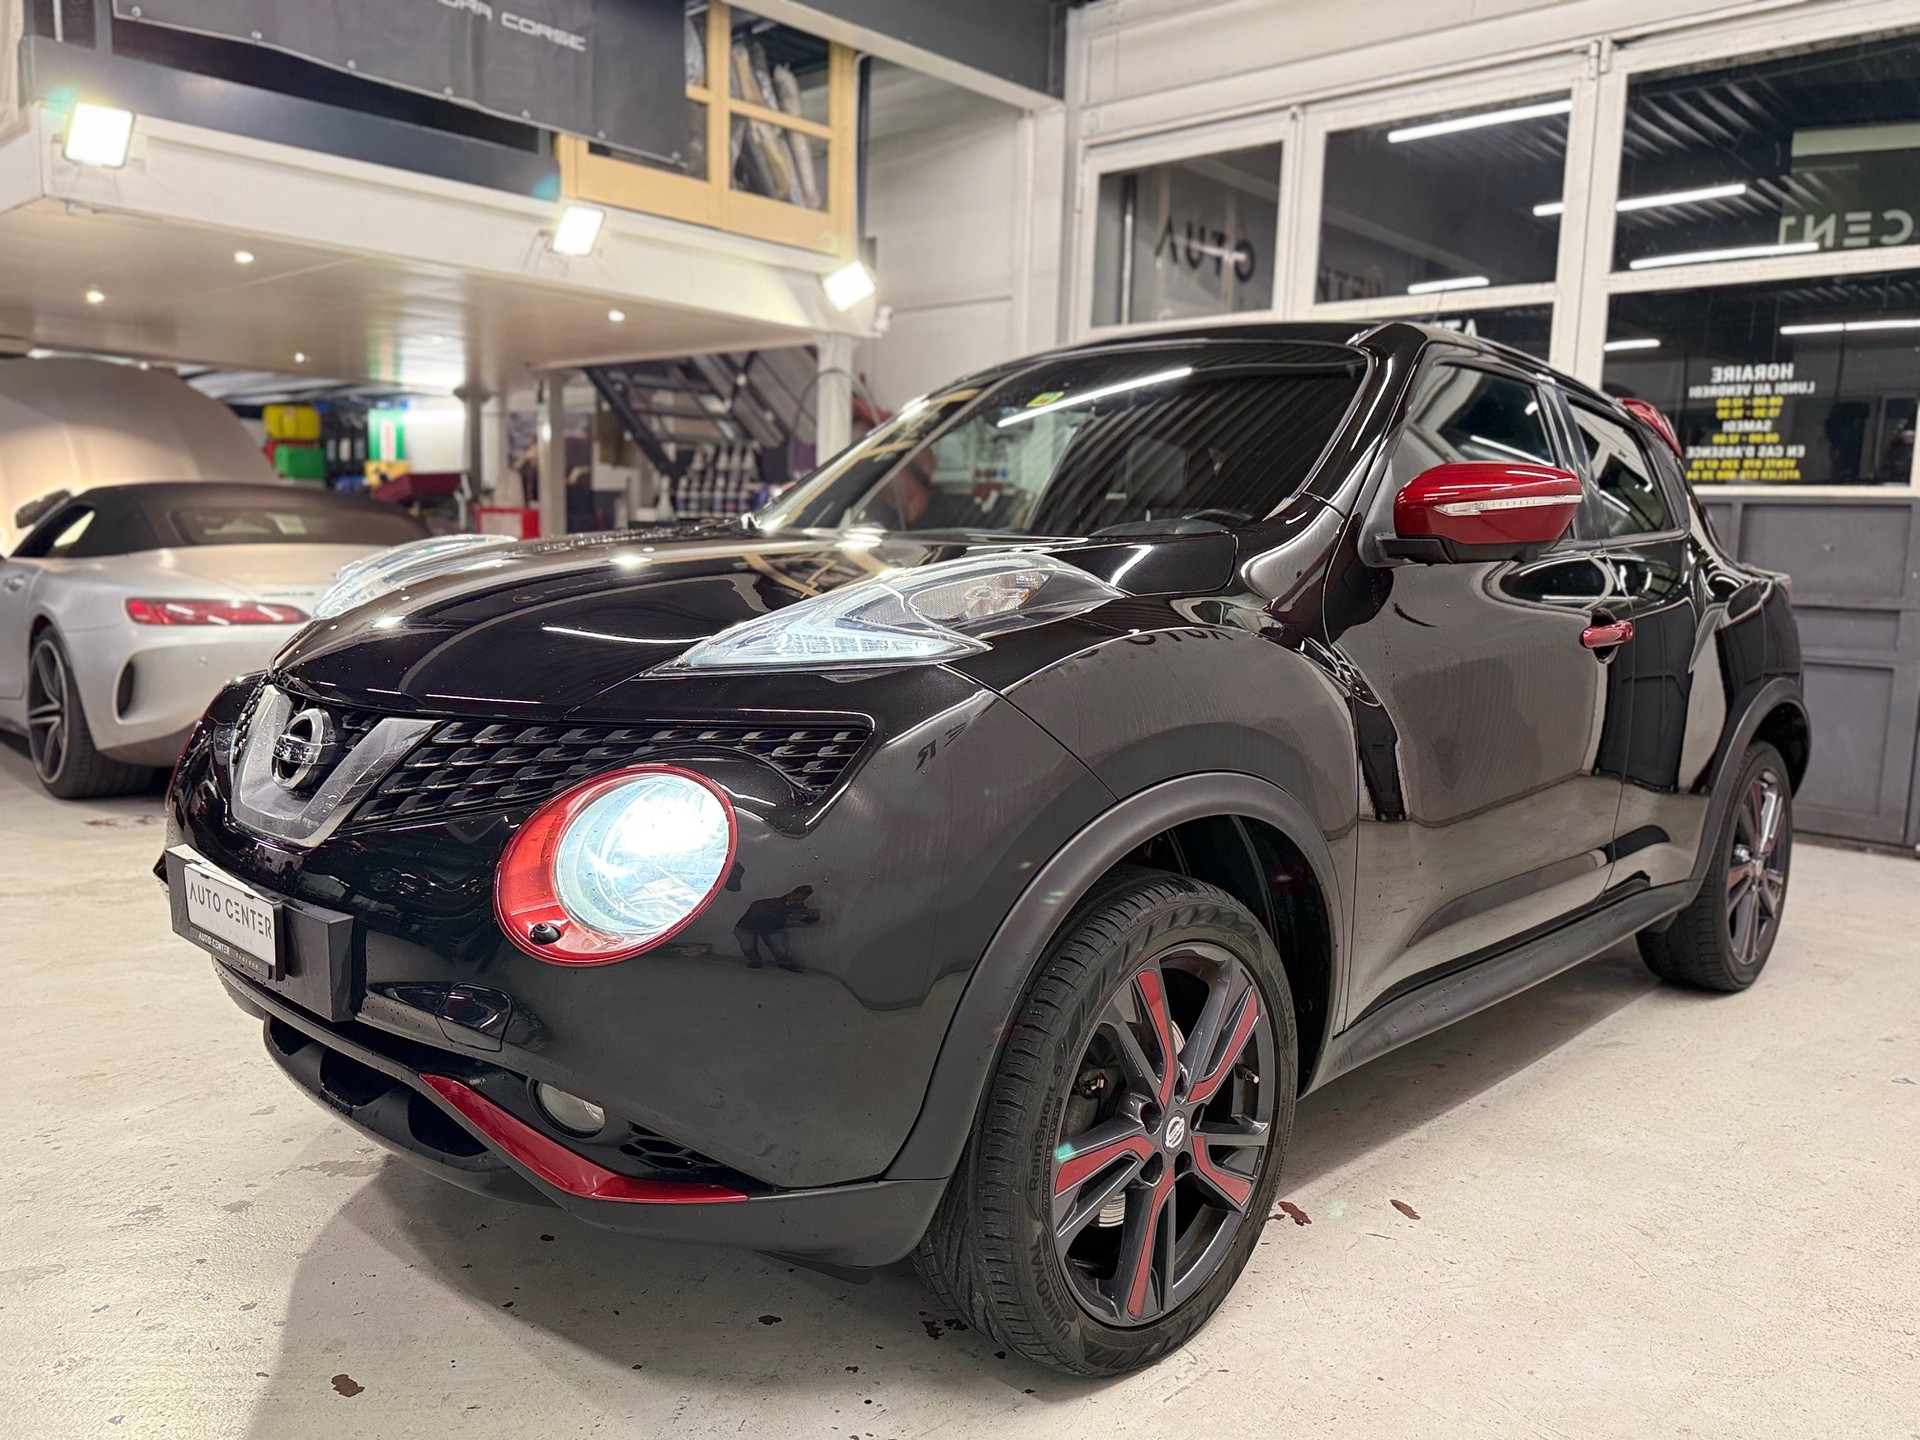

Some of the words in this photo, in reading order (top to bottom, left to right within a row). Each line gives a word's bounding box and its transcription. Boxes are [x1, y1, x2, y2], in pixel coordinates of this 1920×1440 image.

[189, 881, 221, 913] AUTO
[225, 897, 273, 940] CENTER
[198, 931, 212, 946] AUTO
[212, 938, 231, 956] CENTER
[1029, 1084, 1057, 1192] RainSport
[1028, 1233, 1071, 1341] UNIROYAL
